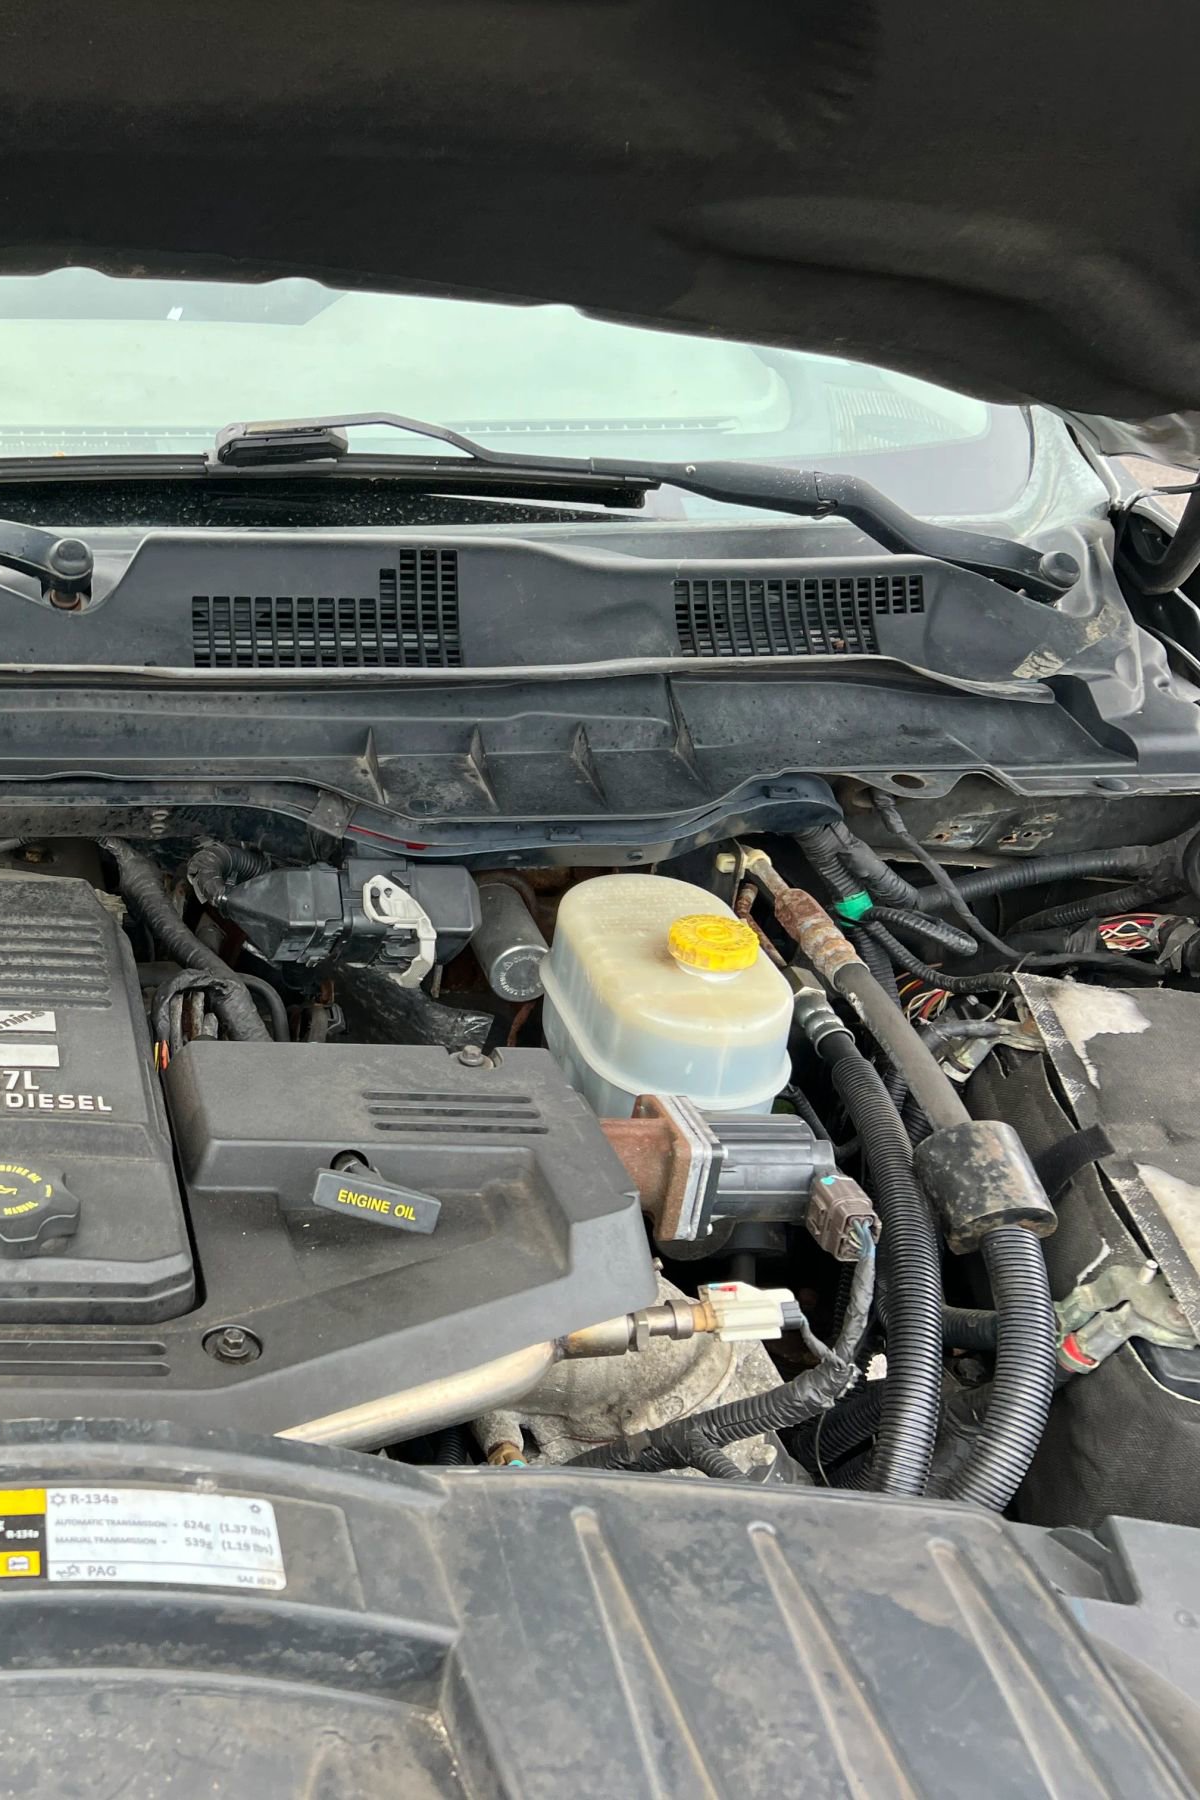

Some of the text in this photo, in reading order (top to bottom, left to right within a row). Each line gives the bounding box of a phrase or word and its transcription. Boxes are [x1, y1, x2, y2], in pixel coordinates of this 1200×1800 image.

[6, 1093, 113, 1112] DIESEL
[26, 1172, 42, 1184] OIL
[337, 1189, 416, 1221] ENGINE OIL
[70, 1493, 118, 1505] R-134a
[55, 1519, 103, 1527] AUTOMATIC
[106, 1519, 168, 1528] TRANSMISSION
[183, 1520, 212, 1533] 624g
[219, 1521, 247, 1535] (1.37
[55, 1536, 92, 1544] MANUAL
[94, 1536, 157, 1545] TRANSMISSION
[185, 1537, 213, 1550] 539g
[87, 1565, 117, 1577] PAG
